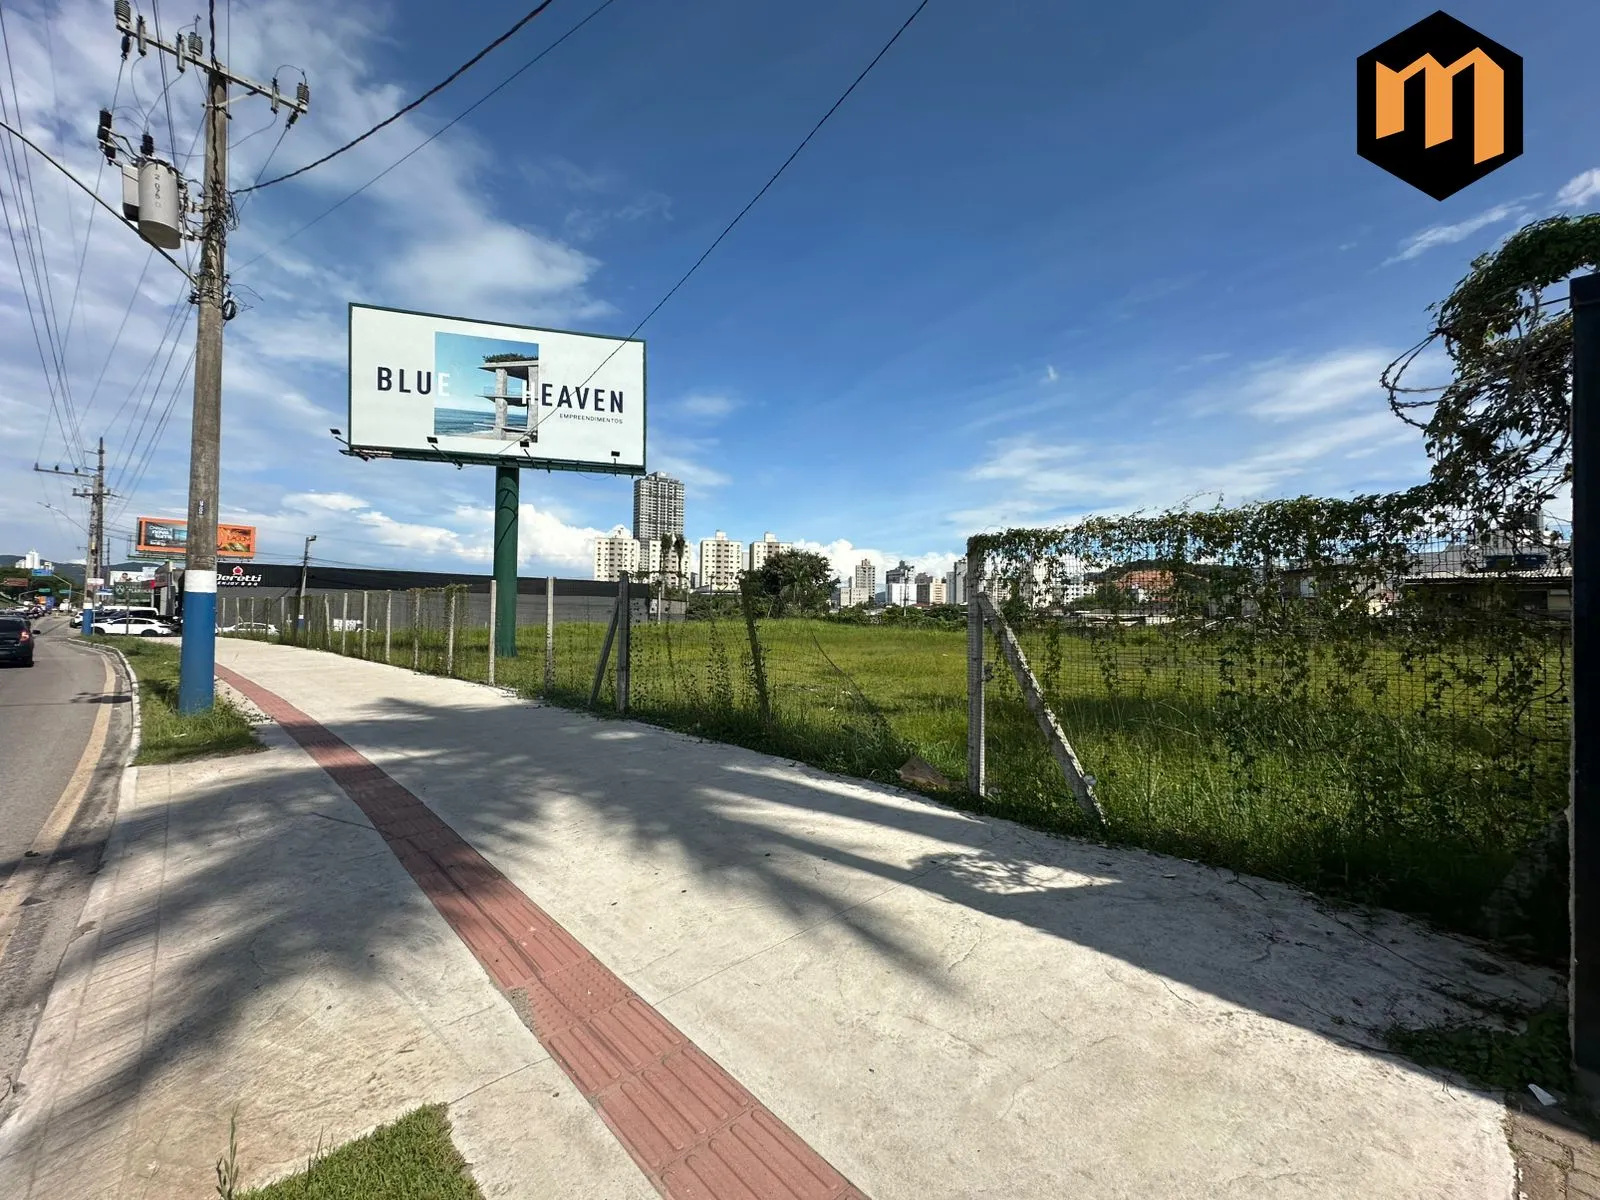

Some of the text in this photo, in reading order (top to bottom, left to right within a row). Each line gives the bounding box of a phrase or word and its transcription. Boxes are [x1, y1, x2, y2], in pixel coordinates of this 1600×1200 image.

[377, 366, 624, 414] BLUE HEAVEN
[559, 413, 623, 425] EMPREENDIMENTOS
